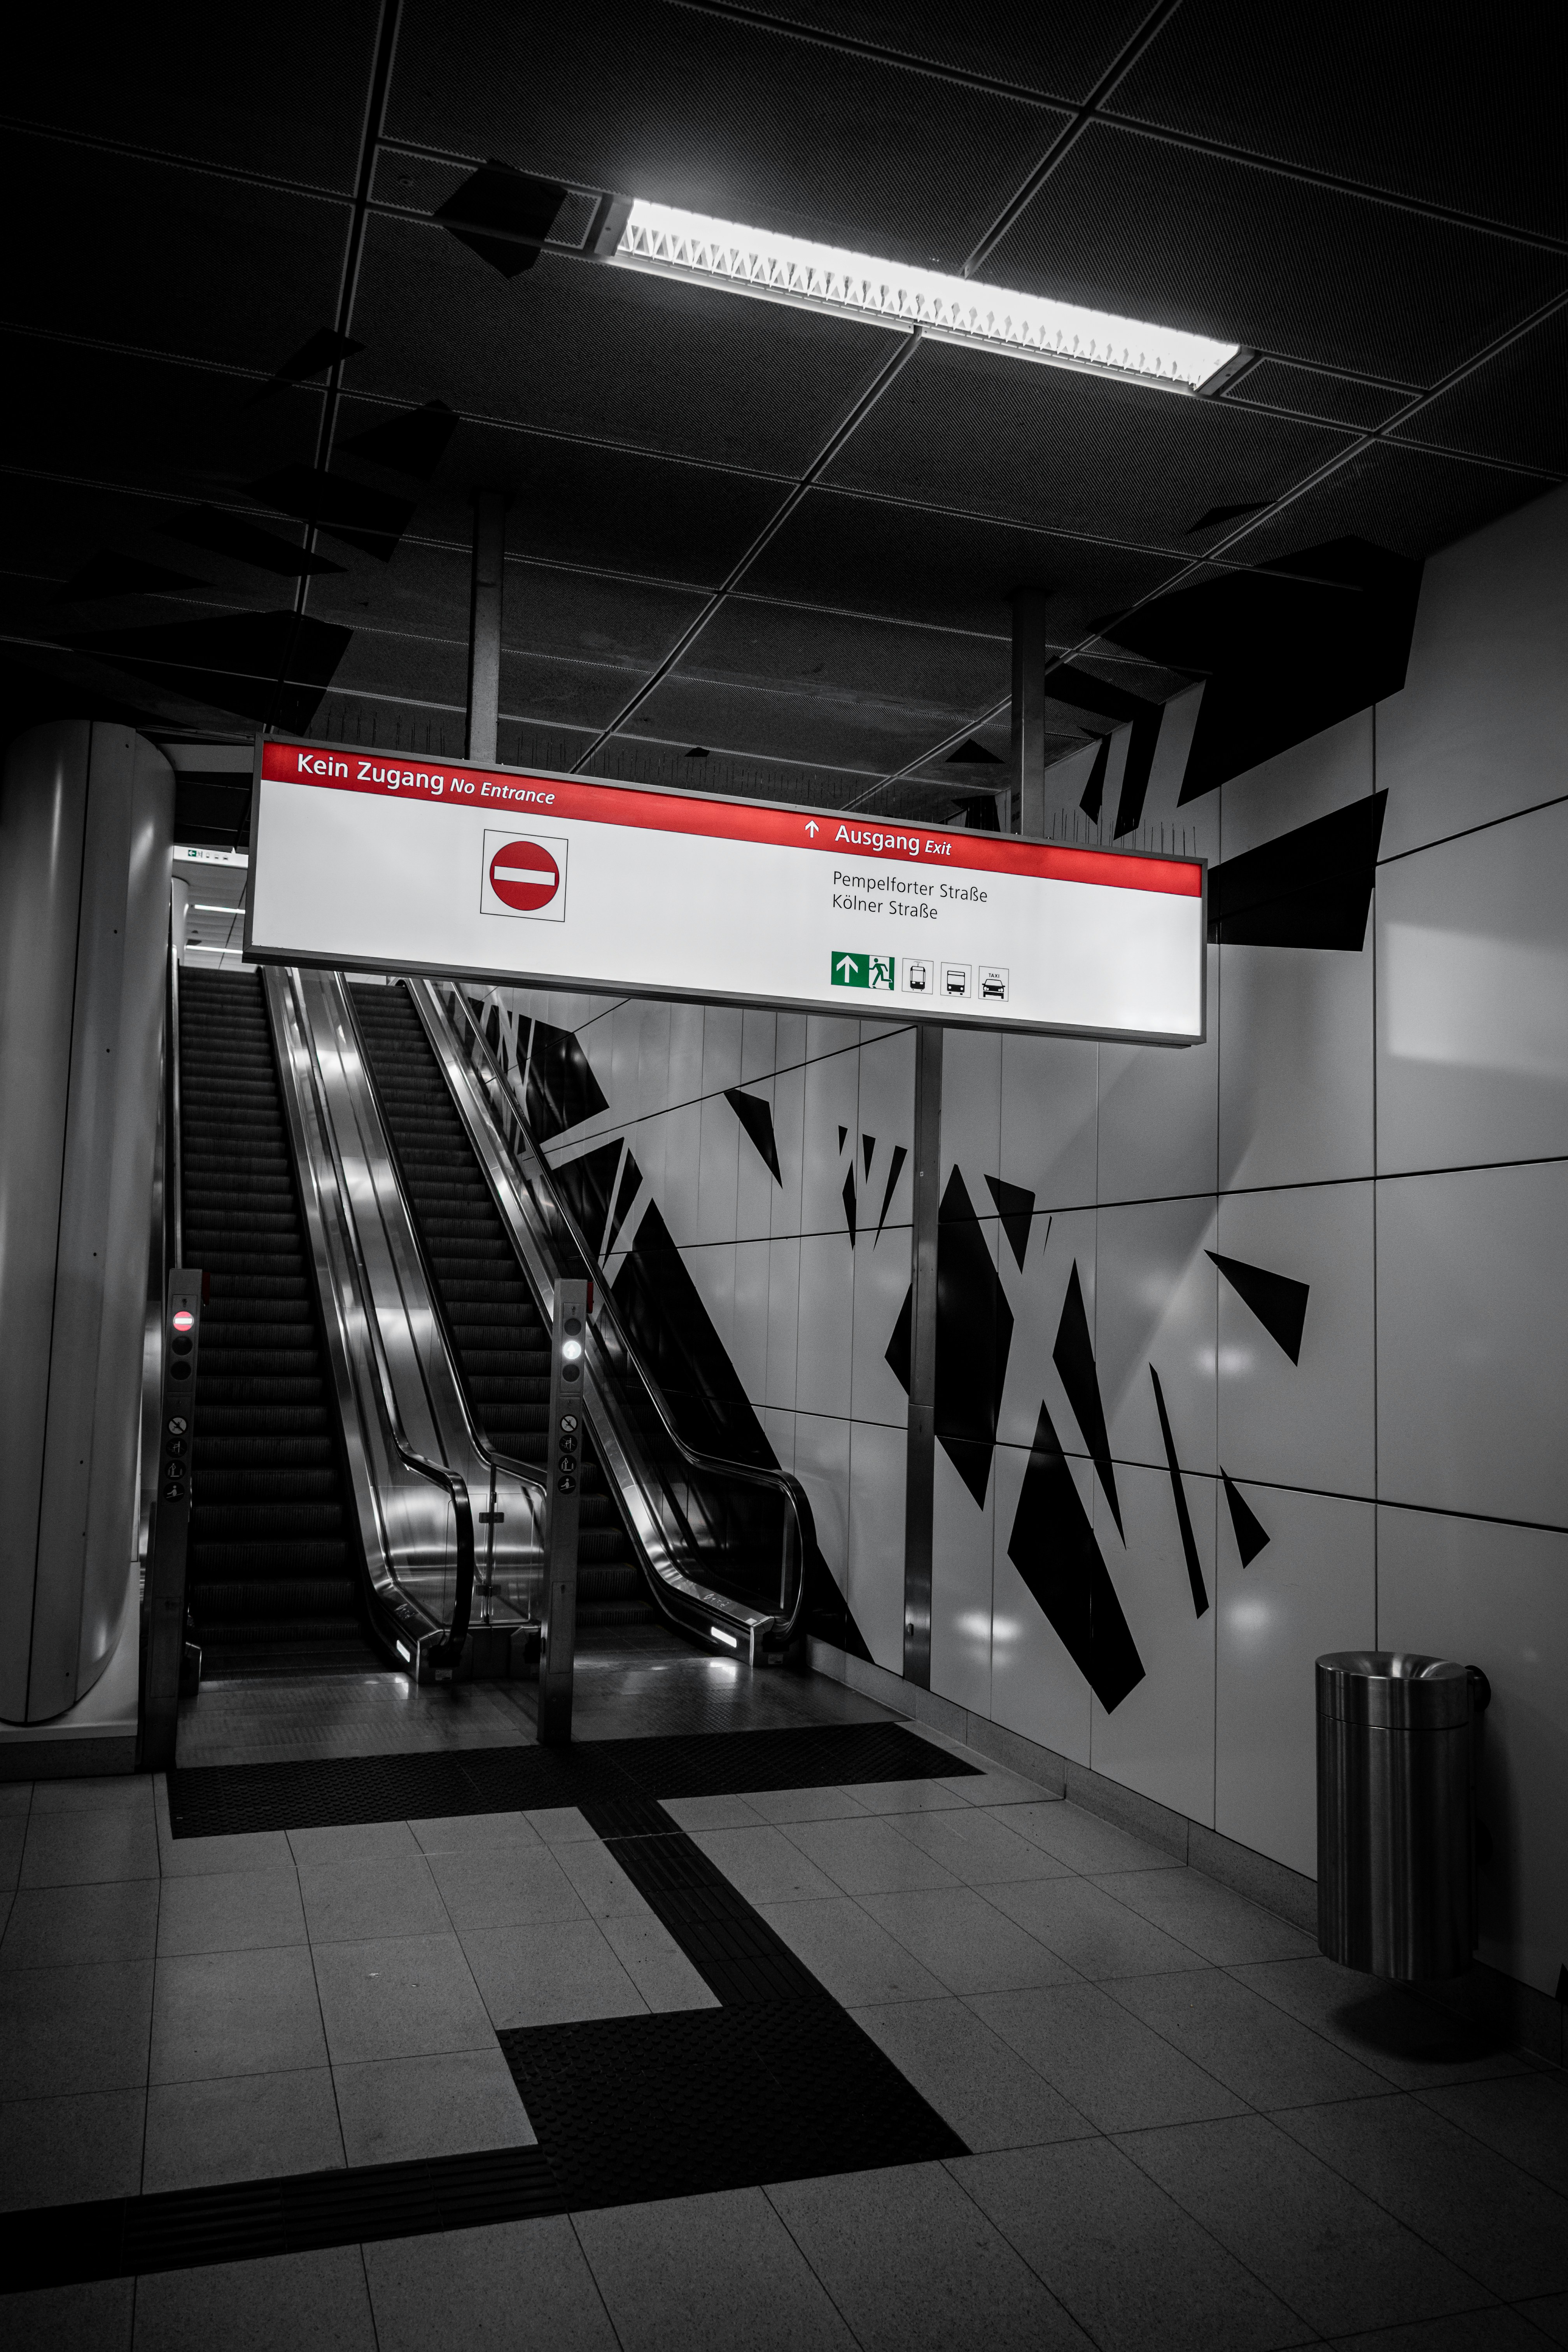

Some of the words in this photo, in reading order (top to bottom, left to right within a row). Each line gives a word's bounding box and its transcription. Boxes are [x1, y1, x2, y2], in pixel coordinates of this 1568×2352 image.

[298, 753, 348, 778] Kein
[357, 761, 444, 795] Zugang
[450, 777, 475, 794] No
[480, 782, 555, 805] Entrance
[835, 824, 920, 856] Ausgang
[924, 840, 952, 856] Exit
[833, 870, 934, 896] Pempelforter
[940, 884, 988, 902] Straße
[833, 894, 883, 913] Kölner
[889, 901, 938, 919] Straße
